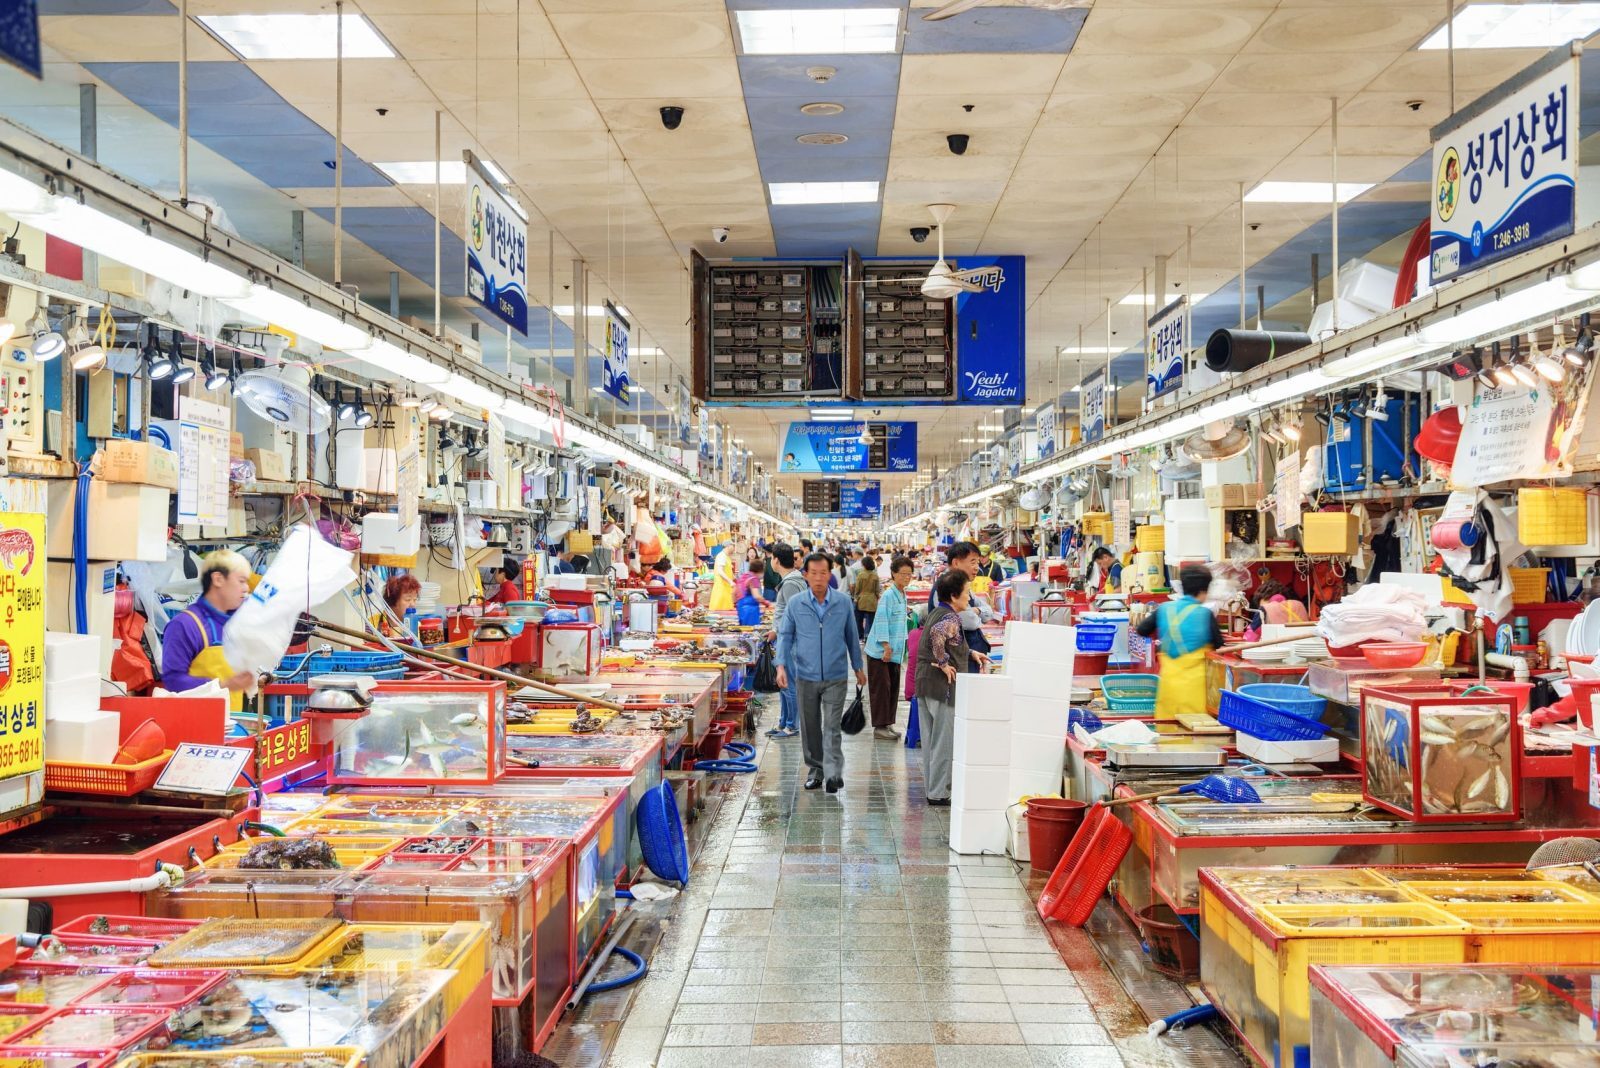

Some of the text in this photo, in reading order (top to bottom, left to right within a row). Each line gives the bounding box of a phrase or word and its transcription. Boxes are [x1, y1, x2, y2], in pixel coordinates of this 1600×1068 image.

[1463, 84, 1568, 204] 성지상회
[485, 201, 526, 286] 해천상회
[1472, 228, 1482, 246] 18
[1493, 221, 1530, 250] T.246-3918
[1156, 315, 1183, 364] 대흥상회
[965, 371, 1009, 391] Yeah!
[974, 387, 1017, 398] Jagalchi
[817, 455, 830, 463] 다시
[186, 747, 237, 760] 자연산
